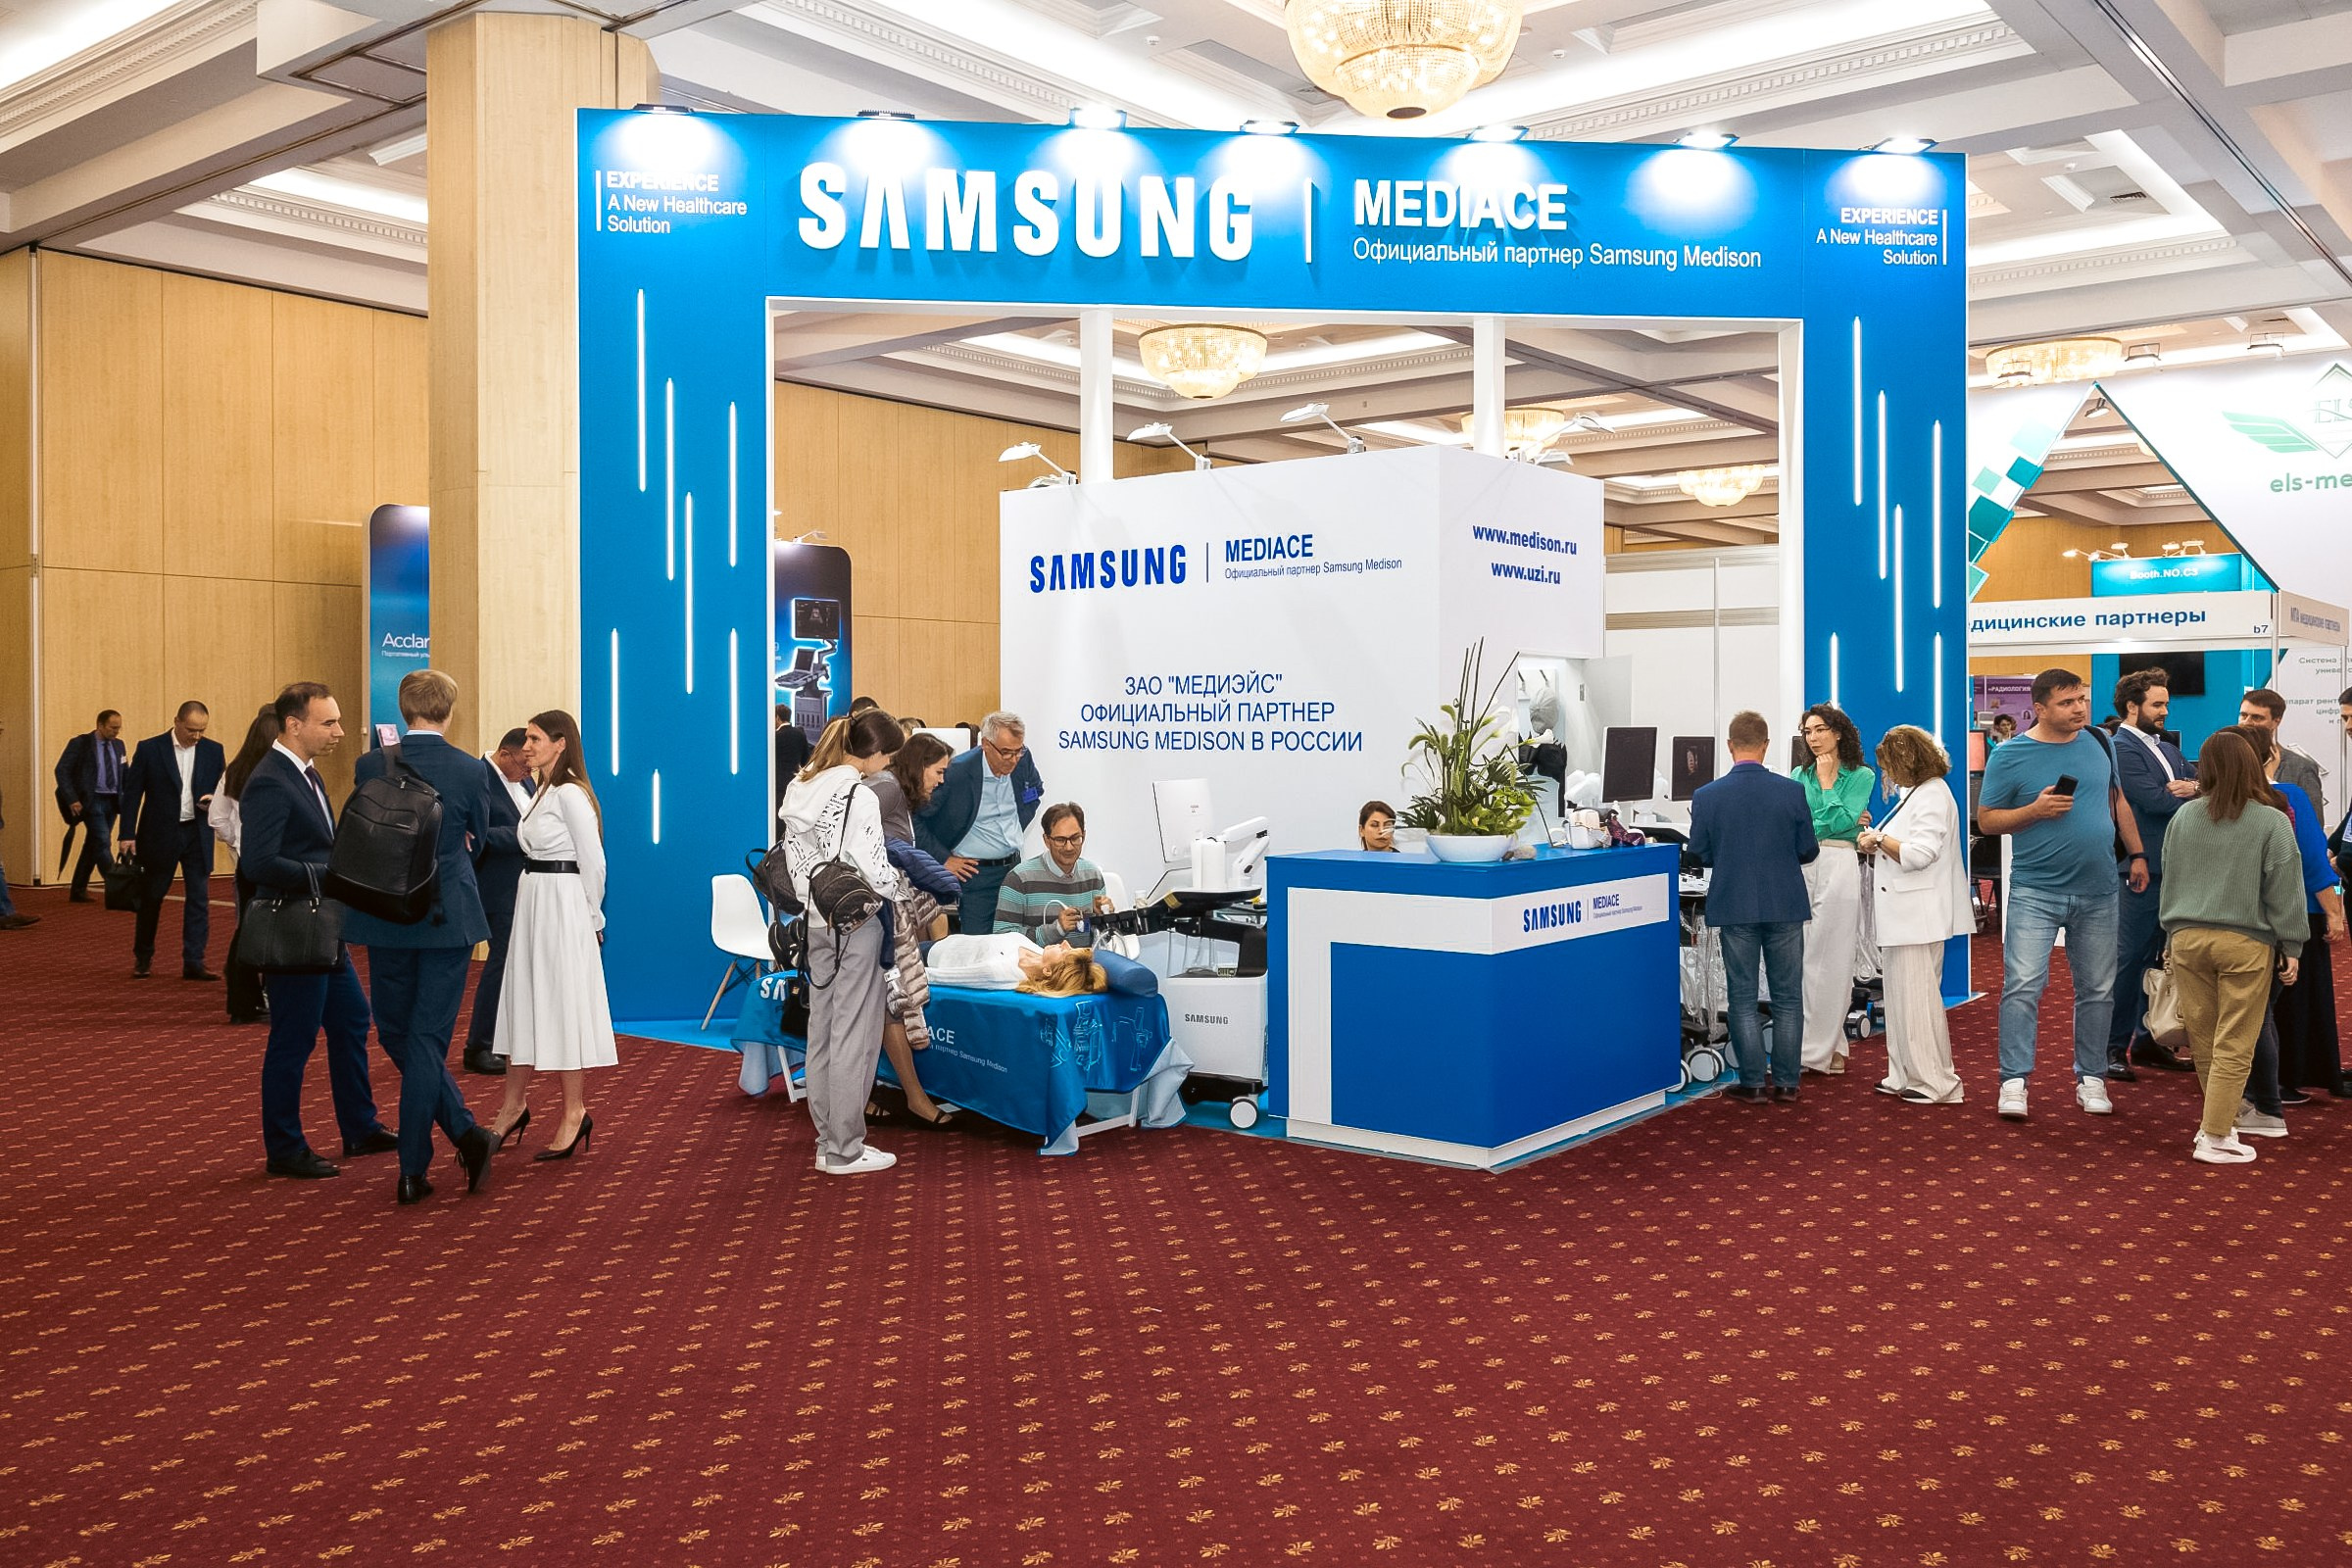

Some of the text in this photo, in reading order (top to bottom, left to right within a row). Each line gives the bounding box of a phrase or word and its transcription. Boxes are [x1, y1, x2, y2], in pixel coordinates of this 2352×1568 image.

[607, 171, 719, 192] EXPERIENCE
[607, 193, 748, 216] A New Healthcare
[798, 161, 1252, 262] SAMSUNG
[1354, 178, 1568, 230] MEDIACE
[607, 215, 671, 234] Solution
[1840, 207, 1938, 225] EXPERIENCE
[1816, 227, 1937, 247] A New Healthcare
[1353, 236, 1762, 272] Официальный партнер Samsung Medison
[1883, 249, 1937, 266] Solution
[1225, 533, 1314, 563] MEDIACE
[1472, 524, 1578, 556] www.medison.ru
[1029, 544, 1187, 594] SAMSUNG
[1224, 557, 1403, 581] Официальный партнер Samsung Medison
[1491, 562, 1561, 585] www.uzi.ru
[1968, 611, 2206, 632] дицинские партнеры
[2253, 624, 2269, 634] b7
[1125, 670, 1283, 698] ЗАО "МЕДИЭЙС"
[1080, 698, 1335, 726] ОФИЦИАЛЬНЫЙ ПАРТНЕР
[1058, 730, 1363, 752] SAMSUNG MEDISON В РОССИИ
[1592, 894, 1620, 909] MEDIACE
[1523, 900, 1582, 933] SAMSUNG
[1185, 1013, 1229, 1025] SAMSUNG
[926, 1025, 956, 1045] ACE
